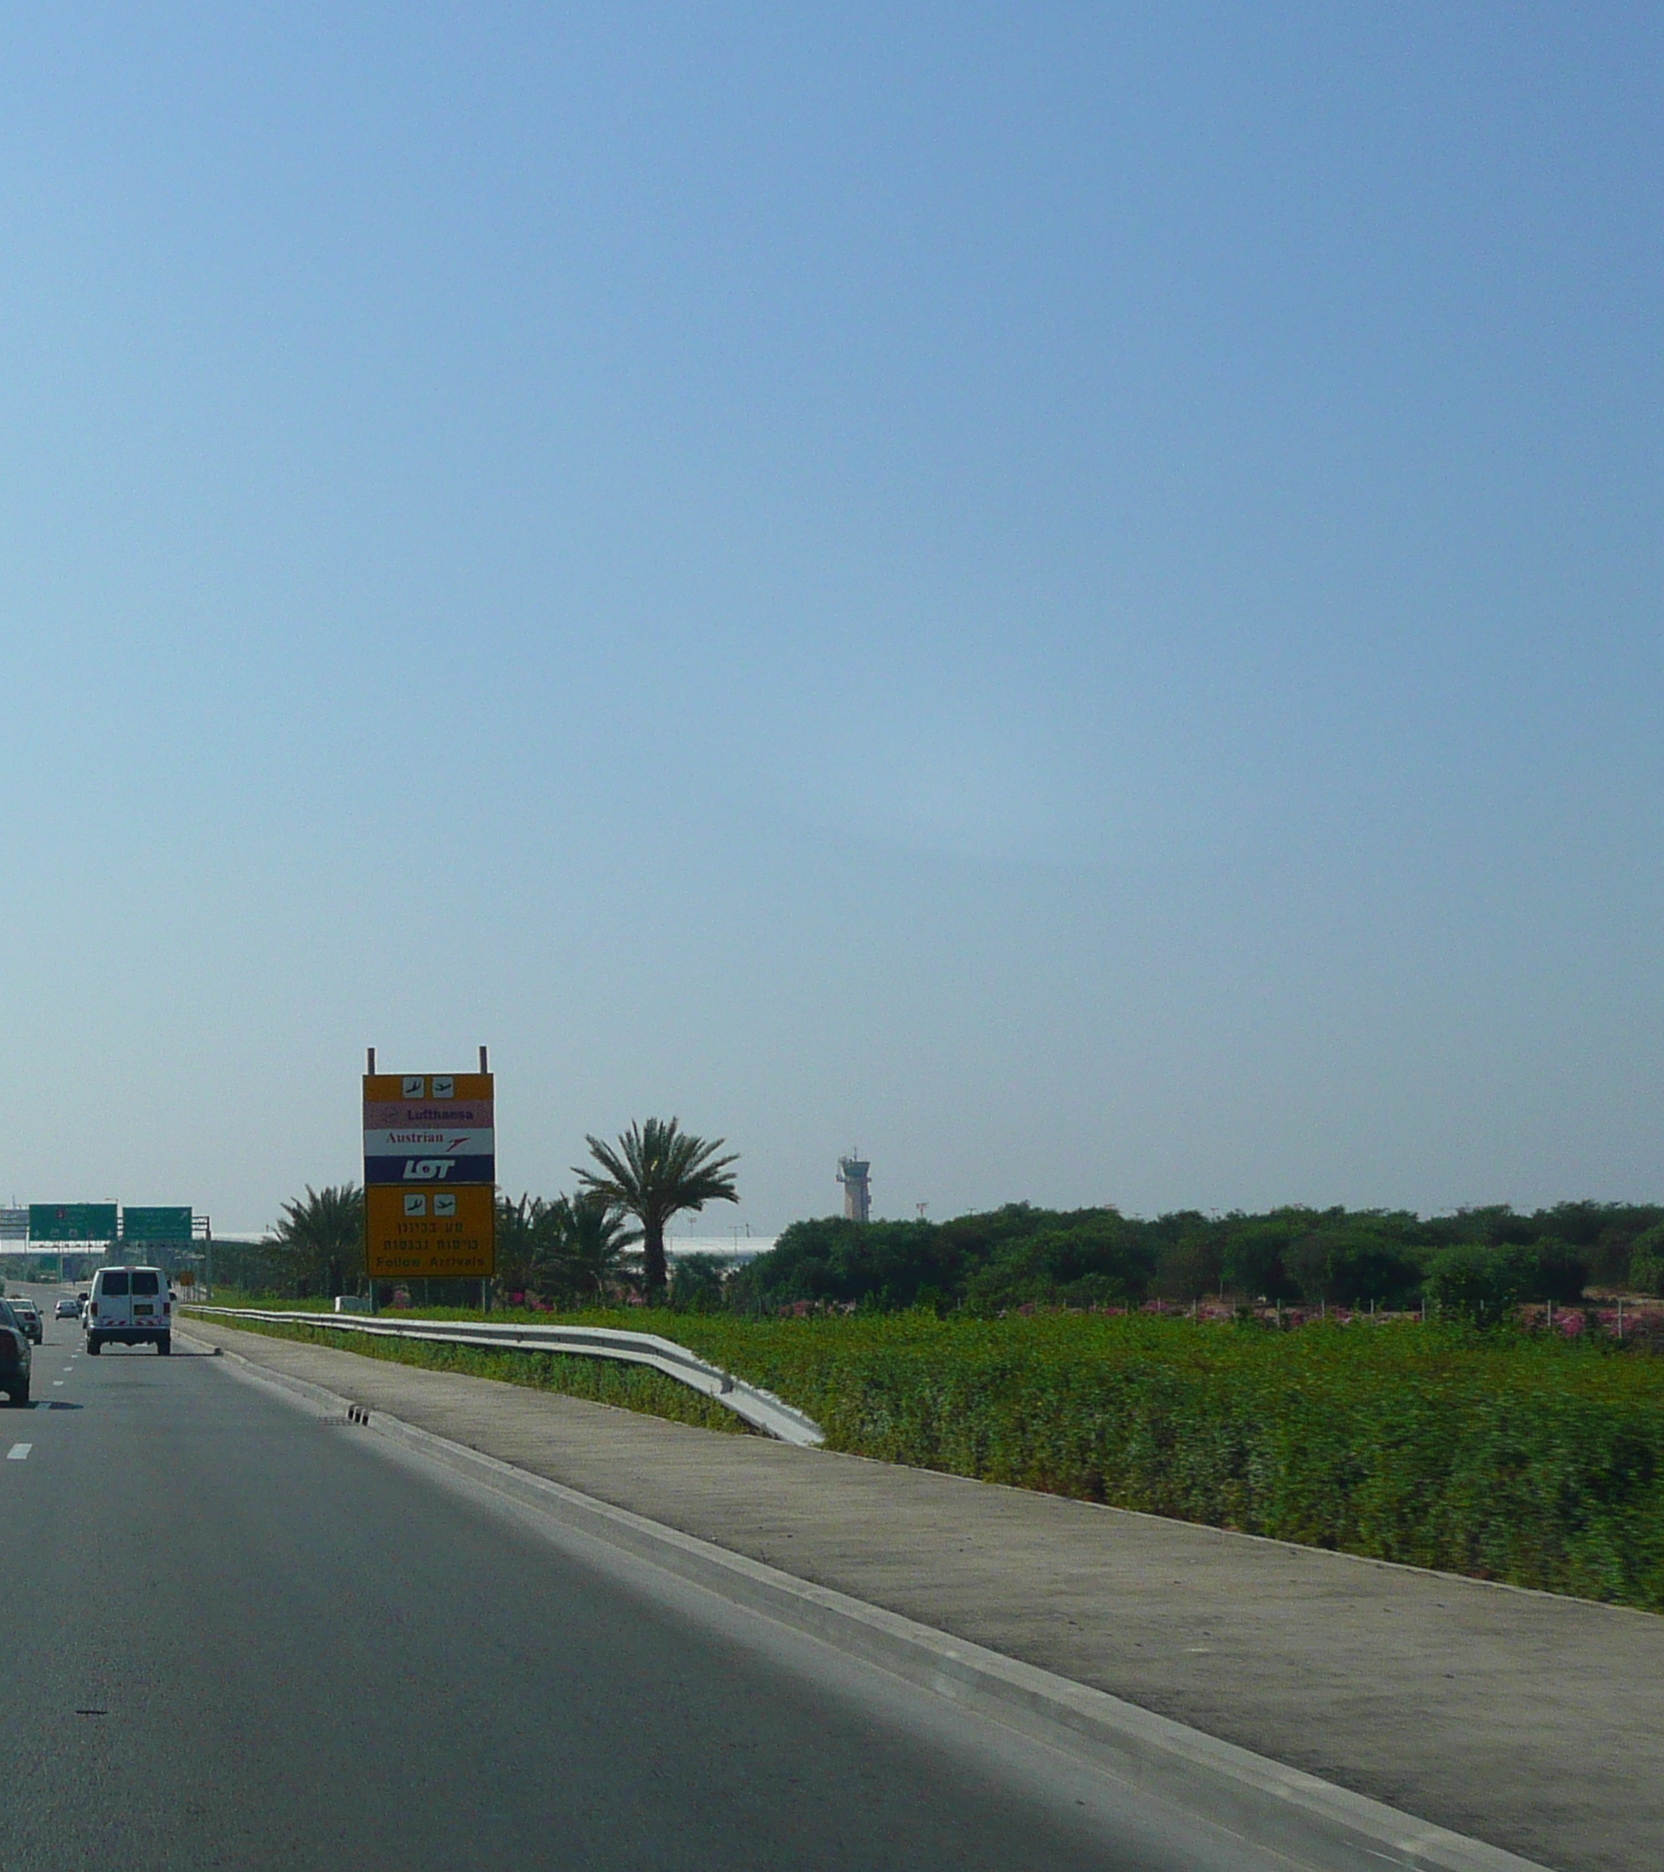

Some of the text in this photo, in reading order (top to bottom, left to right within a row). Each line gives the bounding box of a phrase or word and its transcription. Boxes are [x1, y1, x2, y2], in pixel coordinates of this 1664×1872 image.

[407, 1108, 474, 1120] Lufthansa
[386, 1132, 444, 1143] Austrian
[403, 1160, 455, 1179] LOT
[376, 1256, 485, 1267] Follow Arrivals
